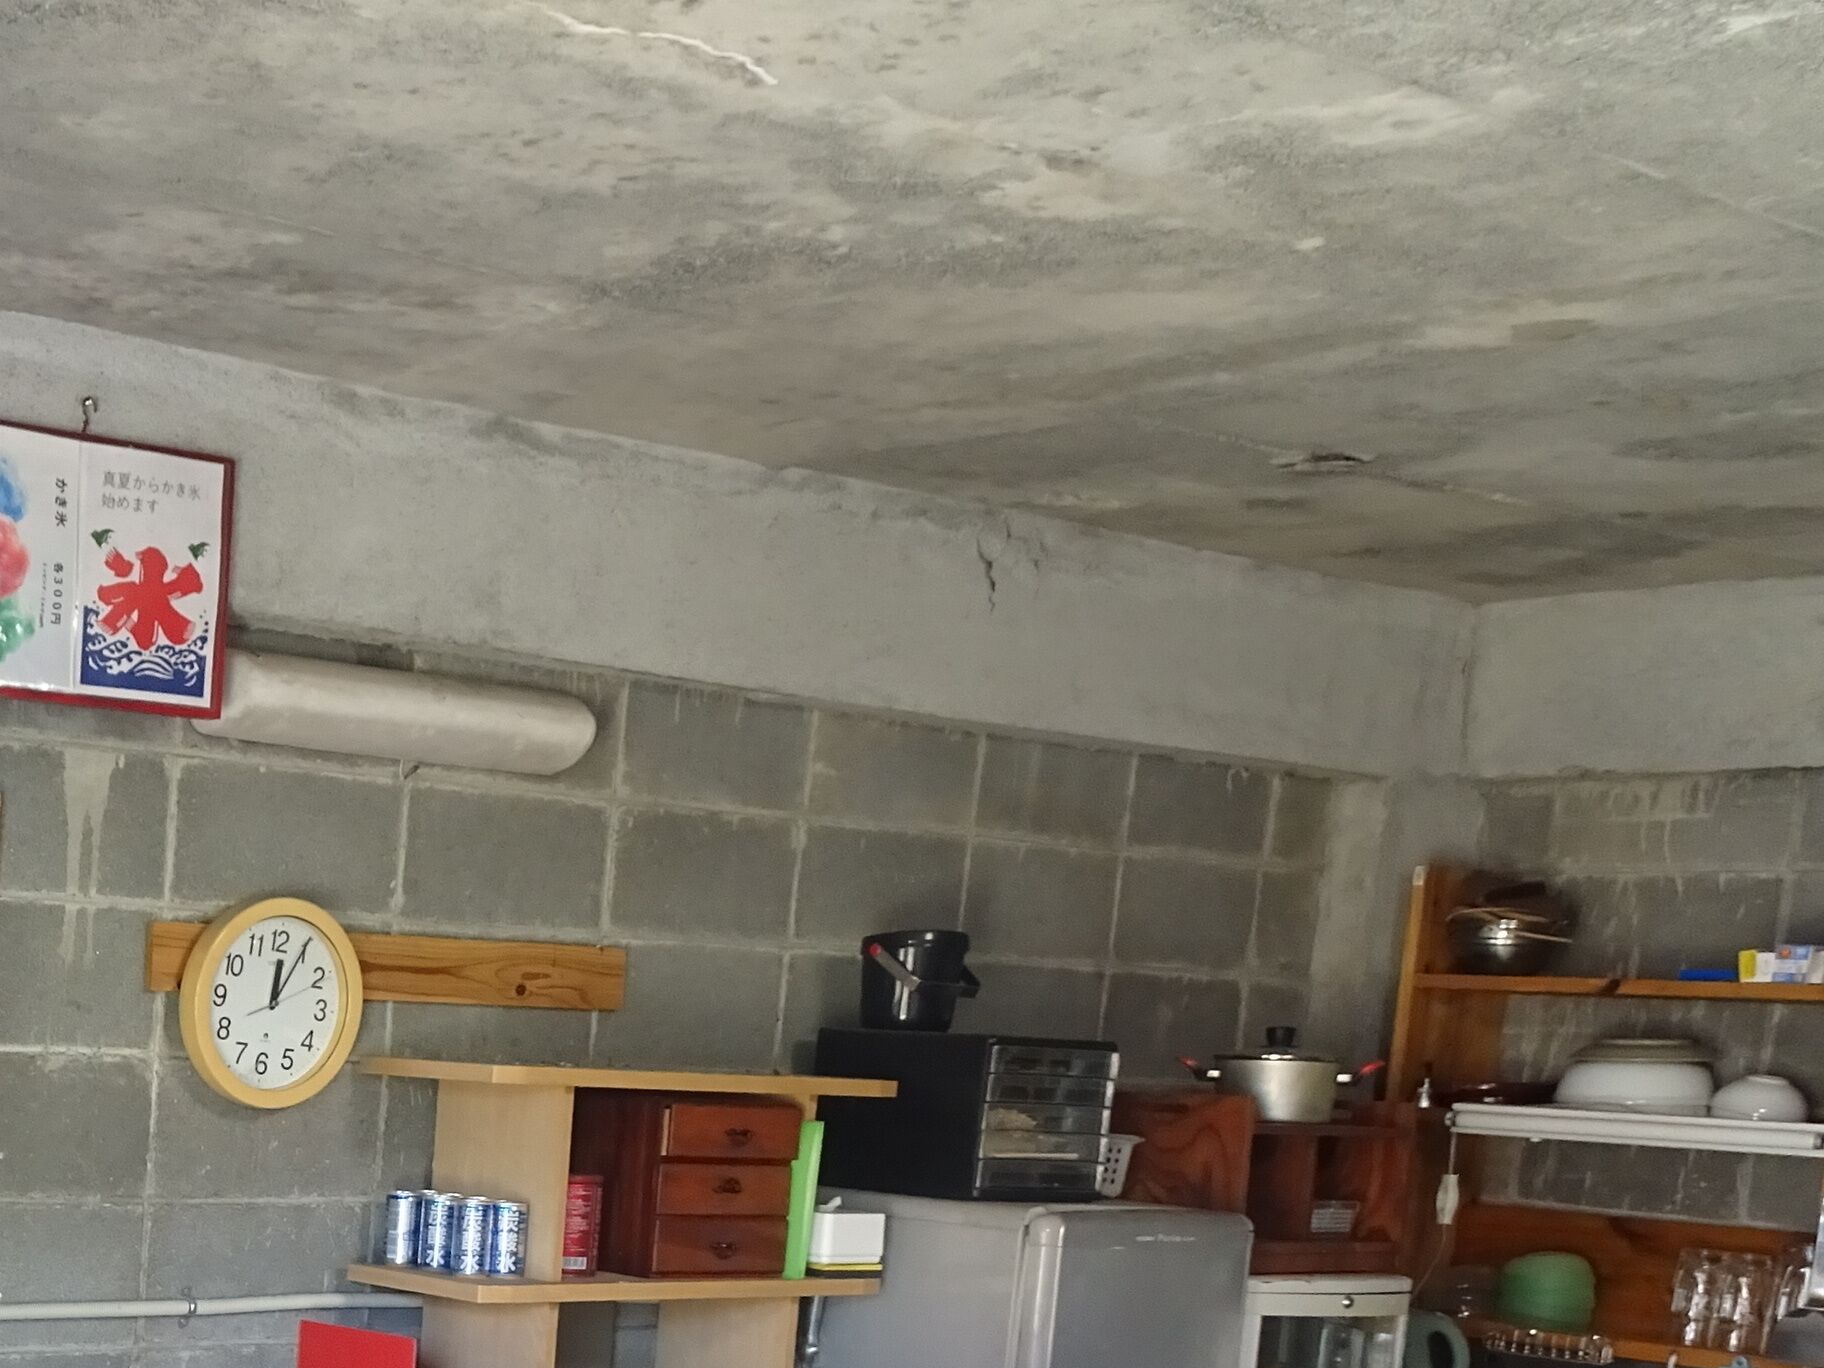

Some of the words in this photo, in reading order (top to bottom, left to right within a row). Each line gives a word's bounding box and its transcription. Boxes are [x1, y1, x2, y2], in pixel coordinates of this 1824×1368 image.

[102, 470, 201, 500] 真夏からかき氷
[55, 478, 68, 528] かき氷
[101, 492, 159, 513] 始めます
[97, 538, 204, 651] 氷
[249, 932, 265, 957] 11
[271, 928, 290, 954] 12
[225, 952, 245, 977] 10
[311, 966, 326, 990] 2
[212, 983, 228, 1007] 9
[313, 999, 328, 1022] 3
[216, 1016, 232, 1040] 8
[300, 1029, 315, 1052] 4
[235, 1041, 249, 1065] 7
[255, 1051, 269, 1075] 6
[280, 1048, 295, 1071] 5
[495, 1207, 521, 1274] 炭酸水
